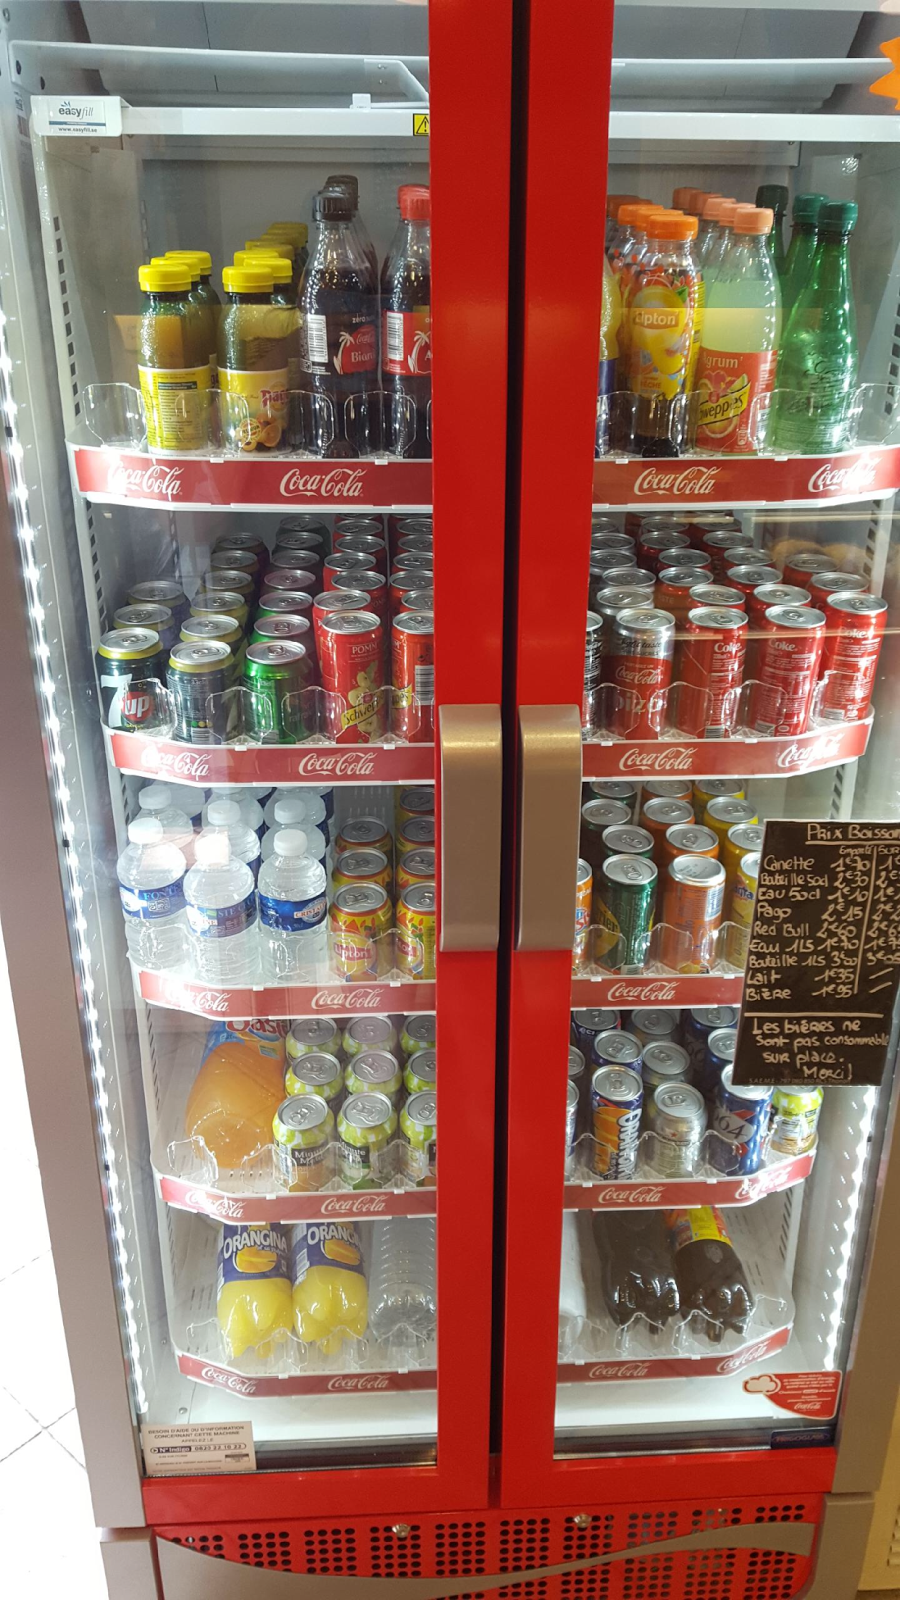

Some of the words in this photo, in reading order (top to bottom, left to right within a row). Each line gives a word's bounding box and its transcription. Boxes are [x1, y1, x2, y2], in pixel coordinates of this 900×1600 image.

[107, 460, 185, 495] Coca-Cola
[279, 468, 368, 497] Coca-Cola
[633, 466, 722, 495] Coca-Cola
[808, 456, 882, 493] Coca-Cola
[768, 638, 798, 651] Coke
[101, 674, 132, 728] 7
[619, 747, 698, 771] Coca-Cola
[778, 732, 845, 768] Coca-Cola
[141, 751, 210, 777] Coca-Cola
[299, 752, 377, 776] Coca-Cola
[763, 854, 815, 871] Canette
[747, 969, 782, 985] Lait
[311, 988, 384, 1009] Coca-Cola
[607, 981, 681, 1002] Coca-Cola
[321, 1195, 390, 1214] Coca-Cola
[598, 1186, 667, 1204] Coca-Cola
[223, 1229, 288, 1258] ORANGINA
[716, 1340, 771, 1373] Coca-Cola
[201, 1366, 257, 1395] Coca-Cola
[327, 1374, 389, 1391] Coca-Cola
[588, 1362, 651, 1379] Coca-Cola
